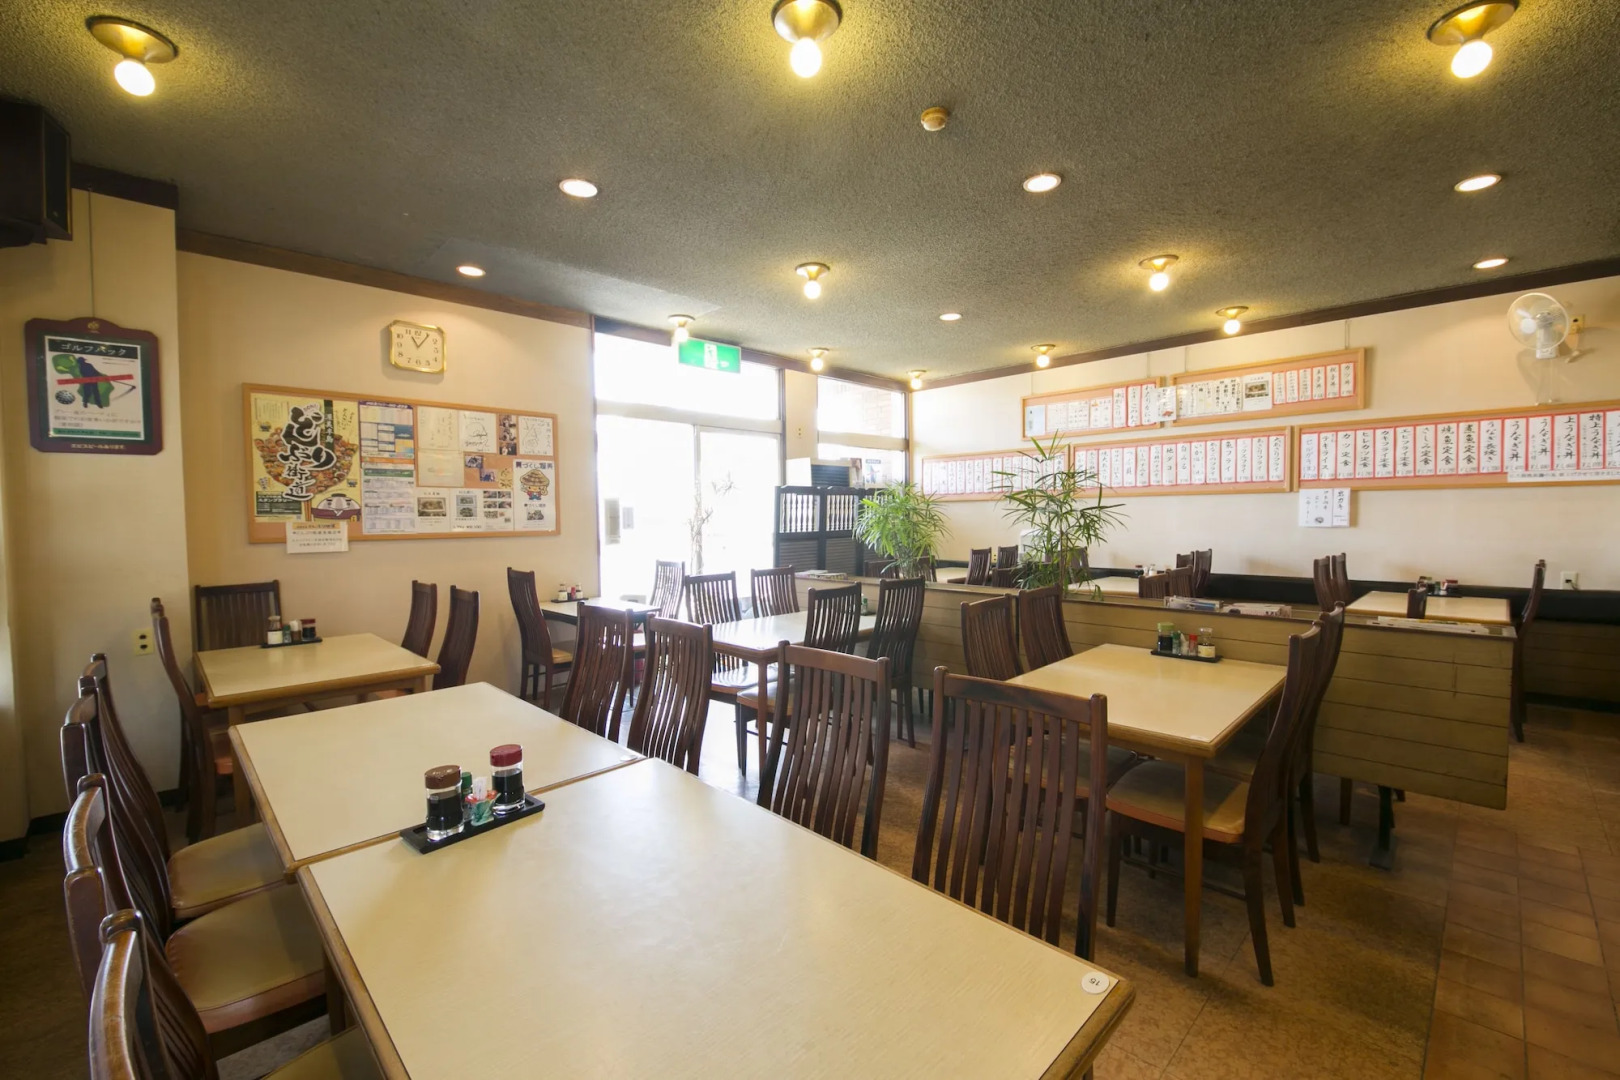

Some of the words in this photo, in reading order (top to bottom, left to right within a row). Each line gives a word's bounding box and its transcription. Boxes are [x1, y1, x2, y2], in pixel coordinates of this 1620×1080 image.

[279, 406, 335, 499] どんぶり街道
[1340, 433, 1351, 467] カツ定食
[1359, 432, 1370, 468] ヒレカツ定食
[1419, 427, 1432, 465] さしみ定食
[1441, 425, 1455, 465] 焼魚定食
[1509, 420, 1522, 462] うなぎ丼
[1538, 418, 1550, 456] うなぎ丼
[1564, 416, 1576, 459] 上うなぎ丼
